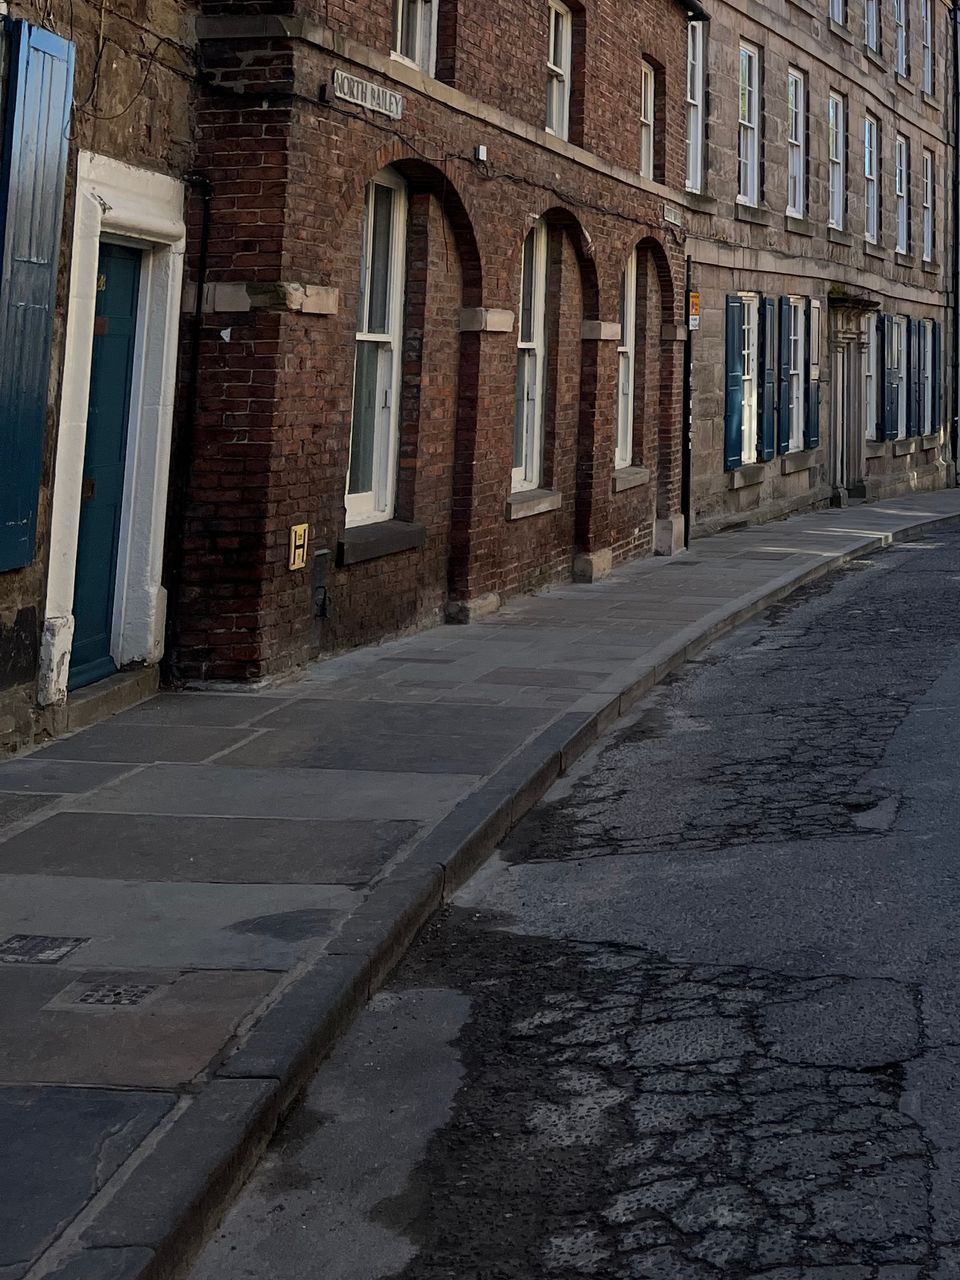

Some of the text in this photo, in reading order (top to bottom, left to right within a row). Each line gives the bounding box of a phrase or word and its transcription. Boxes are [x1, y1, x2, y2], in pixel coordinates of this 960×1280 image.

[335, 72, 401, 115] NORTH BAILEY
[293, 529, 306, 565] H
